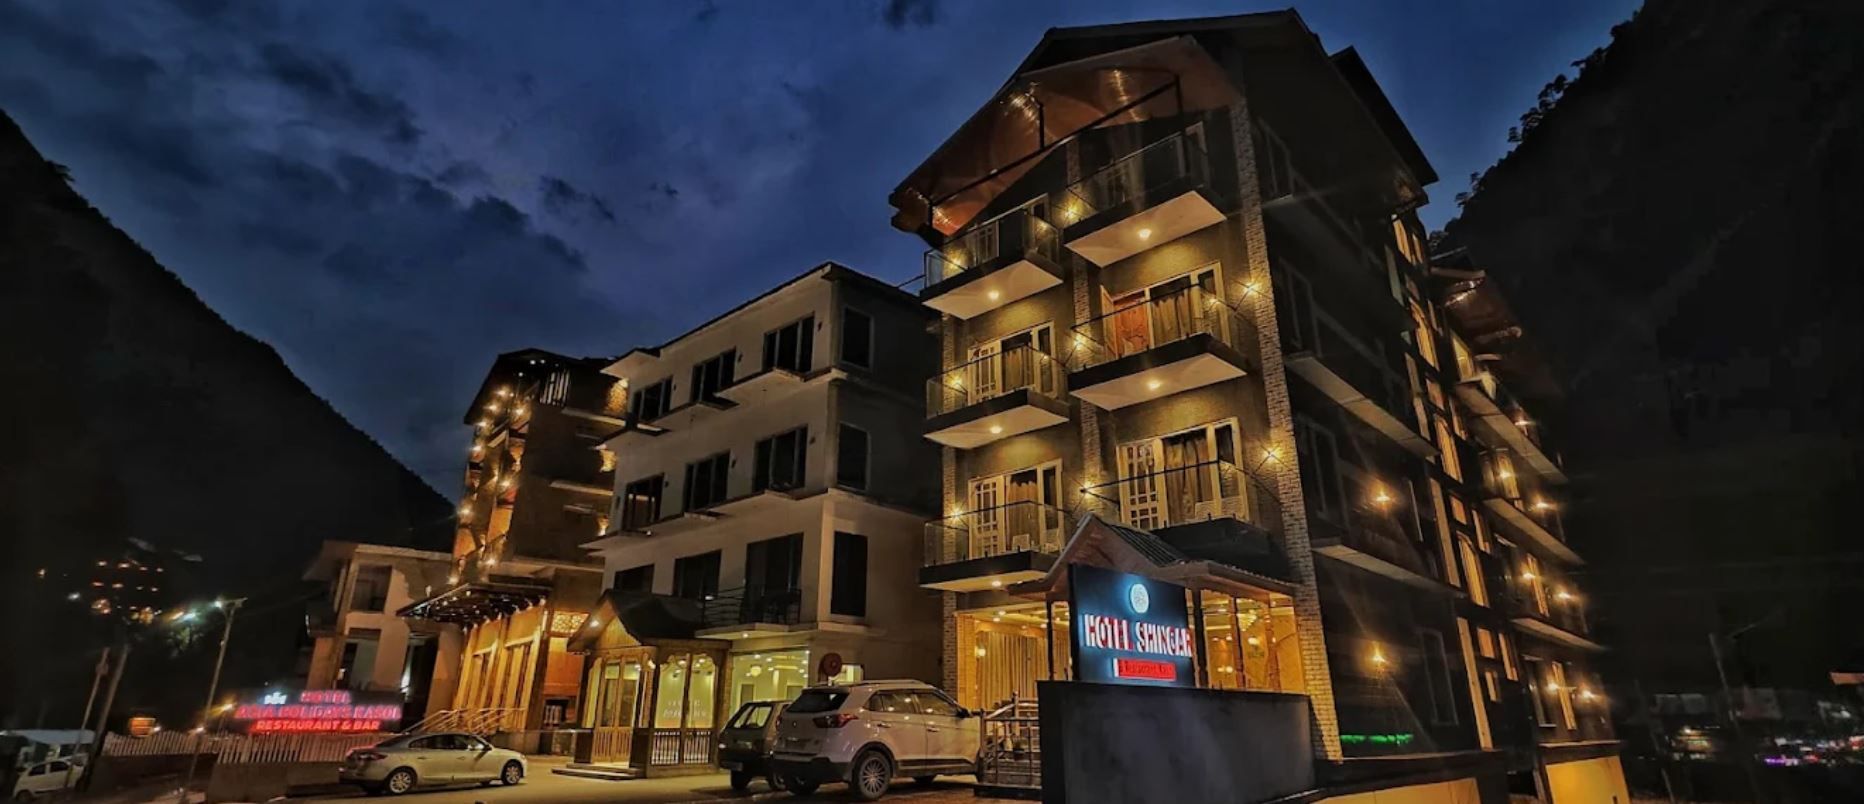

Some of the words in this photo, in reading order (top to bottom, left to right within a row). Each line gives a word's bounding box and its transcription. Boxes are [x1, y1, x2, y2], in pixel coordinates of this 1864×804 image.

[1084, 614, 1133, 650] HOTEL
[1135, 622, 1192, 657] SHINGAR
[301, 690, 351, 703] HOTEL
[353, 705, 401, 719] KASOL
[256, 720, 340, 730] RESTAURANT
[341, 720, 350, 730] &
[353, 720, 380, 730] BAR
